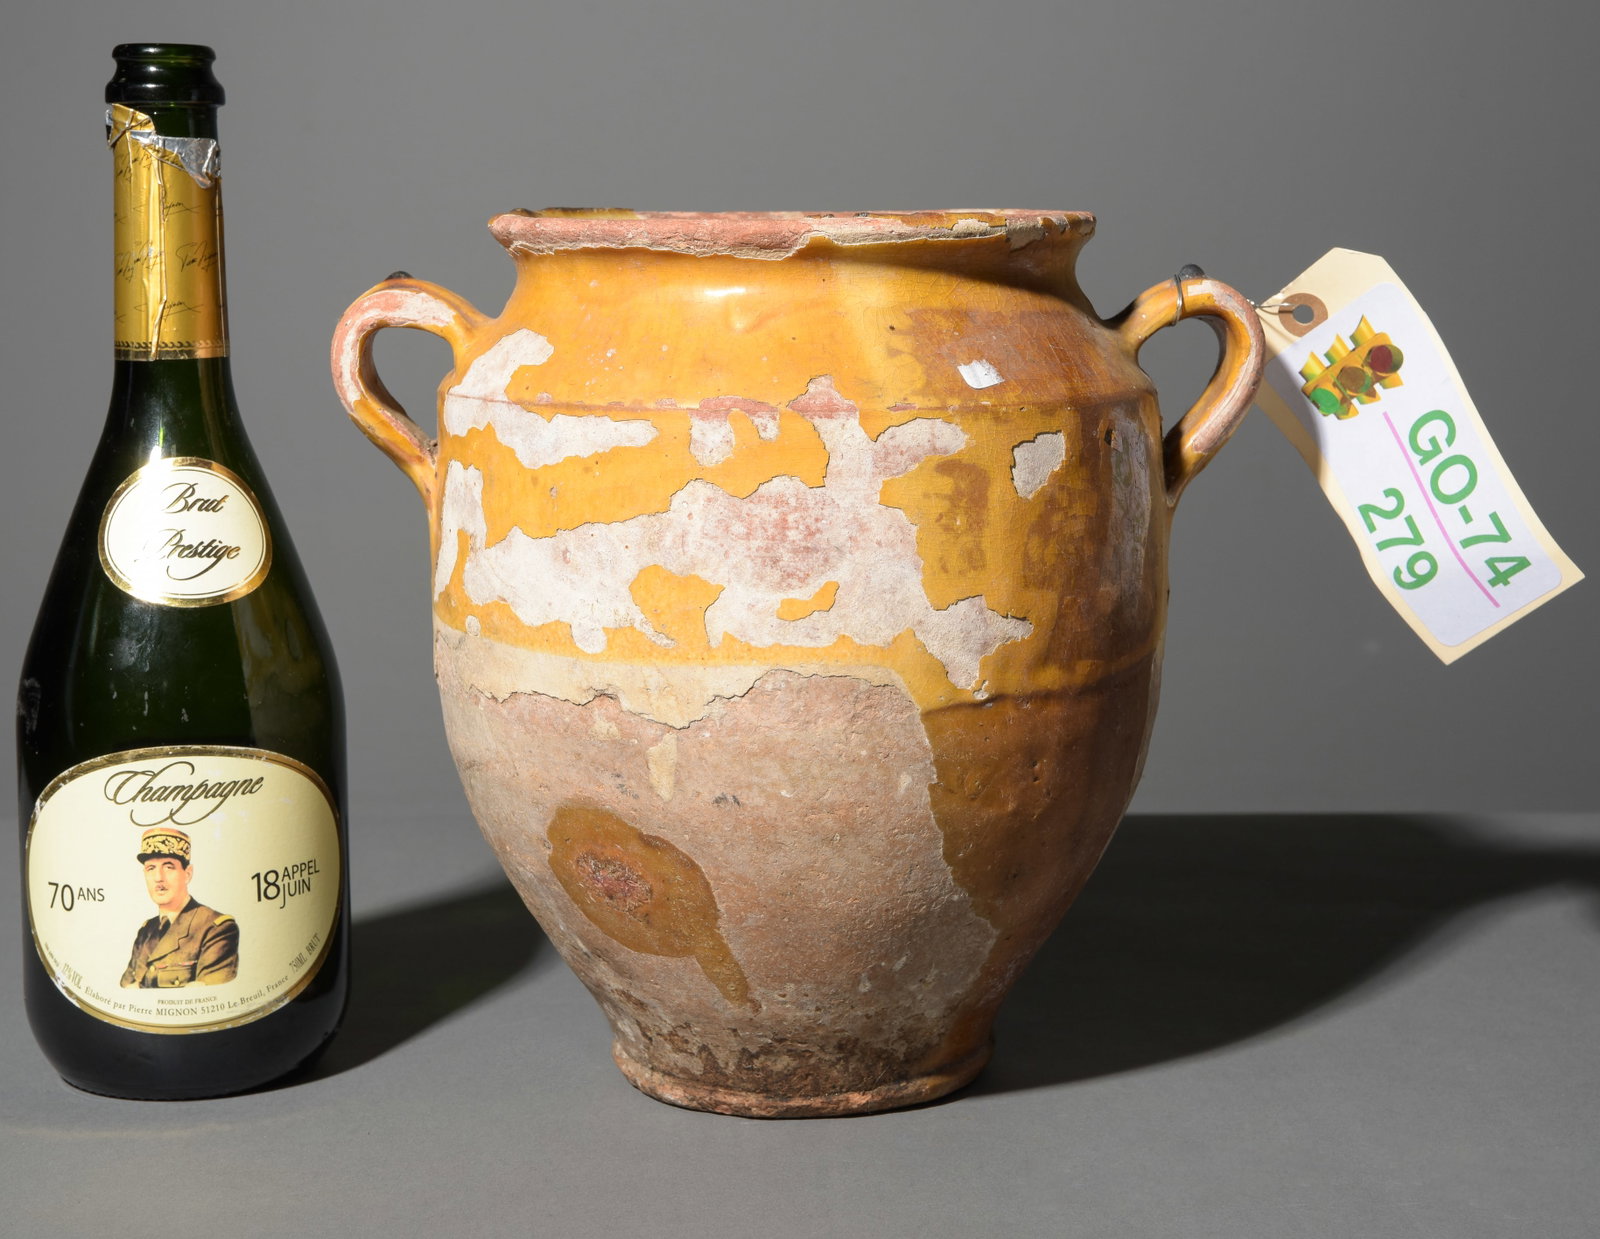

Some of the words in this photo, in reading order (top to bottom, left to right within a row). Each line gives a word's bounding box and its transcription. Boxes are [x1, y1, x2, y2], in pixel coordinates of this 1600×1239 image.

[160, 482, 230, 514] Brut
[1408, 409, 1532, 588] GO-74
[1357, 487, 1439, 590] 279
[104, 761, 265, 827] Champagne
[251, 869, 281, 902] 18
[281, 858, 320, 882] APPEL
[48, 881, 75, 911] 70
[77, 887, 105, 902] ANS
[279, 878, 312, 909] JUIN
[113, 1001, 126, 1010] par
[128, 1003, 152, 1015] Pierre
[156, 1007, 198, 1016] MIGNON
[201, 1003, 225, 1014] 51210
[228, 1001, 237, 1009] Le
[266, 975, 289, 992] France
[305, 932, 321, 956] BRUT
[194, 996, 217, 1004] FRANCE
